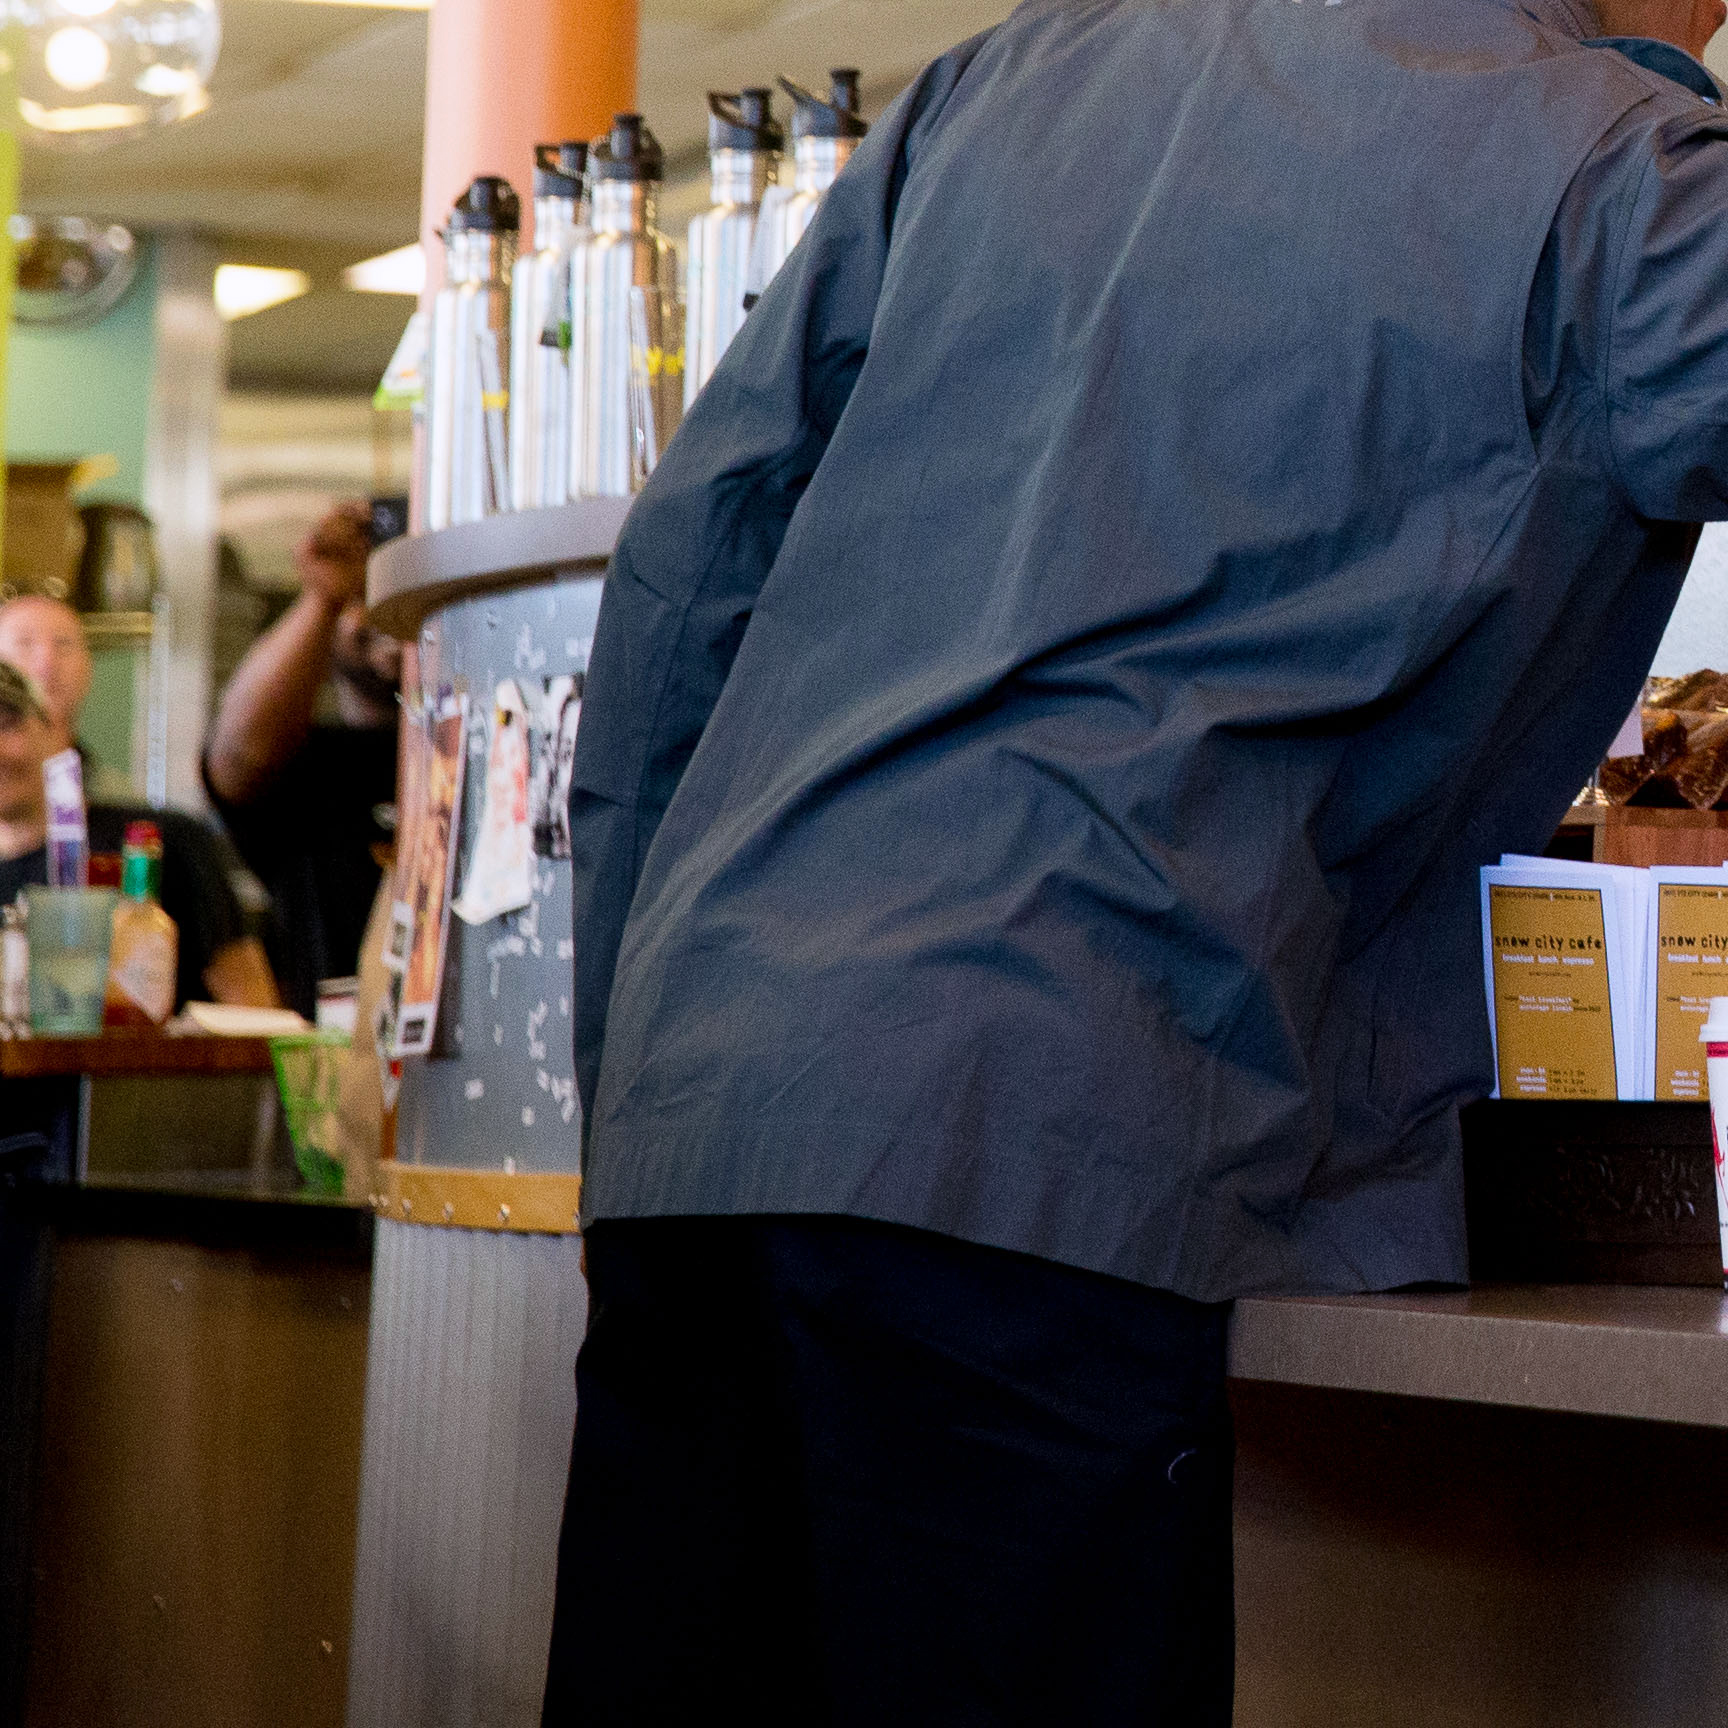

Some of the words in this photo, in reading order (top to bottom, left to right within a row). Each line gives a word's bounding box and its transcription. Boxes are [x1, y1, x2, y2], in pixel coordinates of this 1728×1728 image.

[1494, 935, 1531, 948] snow
[1535, 933, 1564, 952] city
[1568, 934, 1603, 950] cafe
[1660, 933, 1696, 950] snow
[1502, 952, 1535, 964] breakfast
[1667, 952, 1699, 964] breakfast
[1701, 953, 1722, 965] lunch
